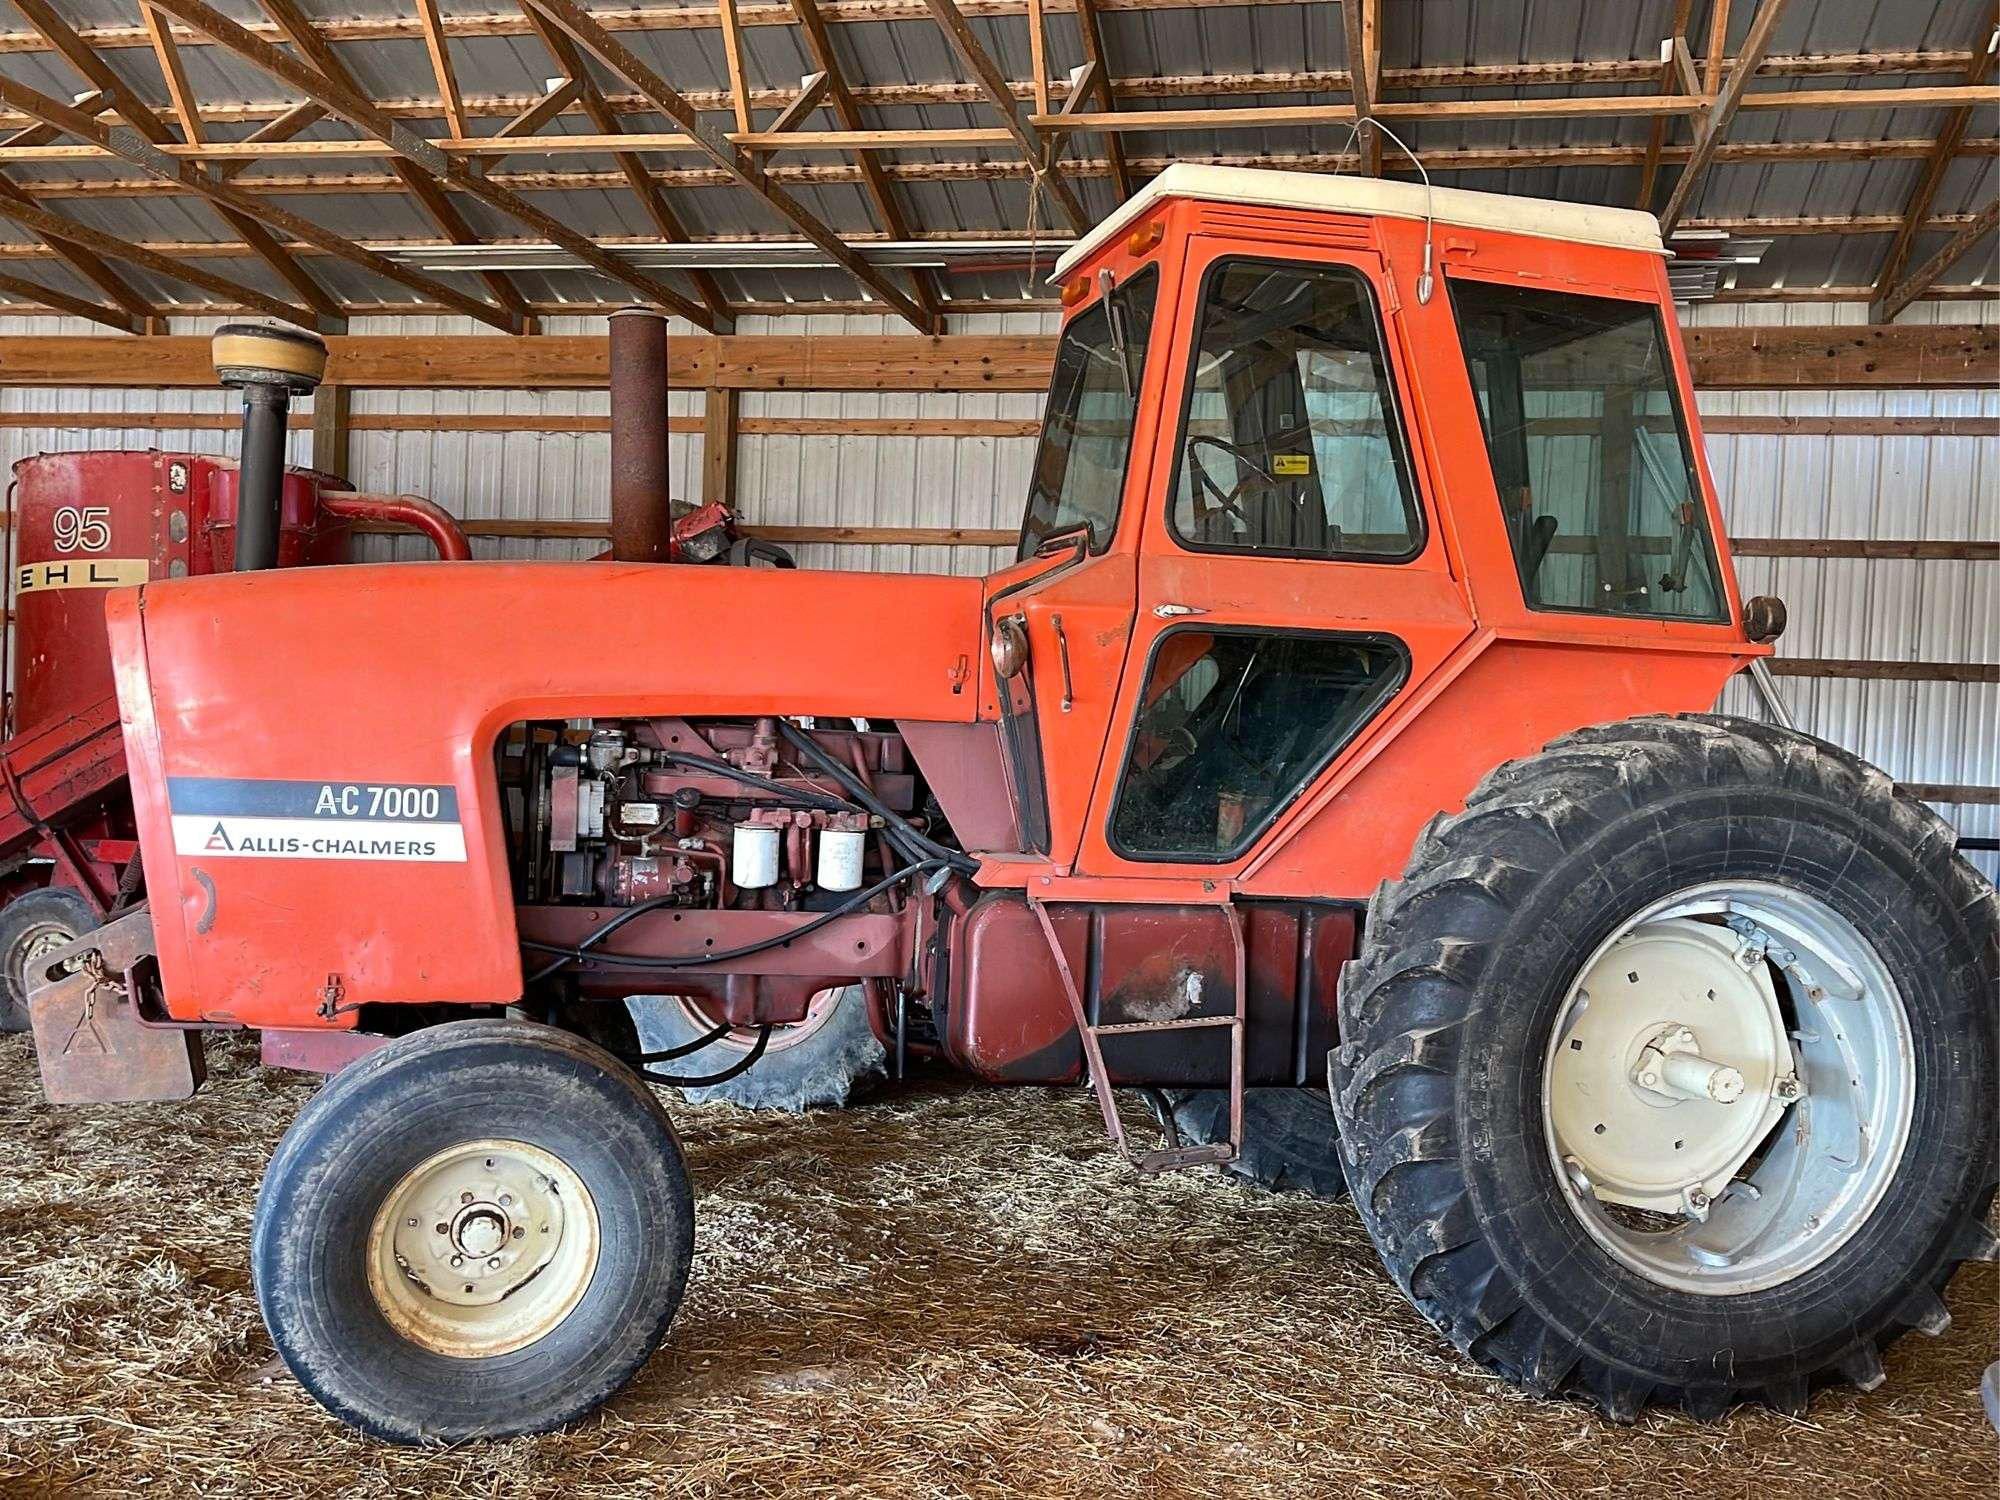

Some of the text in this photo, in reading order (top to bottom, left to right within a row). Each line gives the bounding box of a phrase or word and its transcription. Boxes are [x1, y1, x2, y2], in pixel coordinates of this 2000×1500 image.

[53, 506, 111, 552] 95
[367, 787, 440, 818] 7000
[239, 837, 436, 856] ALLIS-CHALMERS
